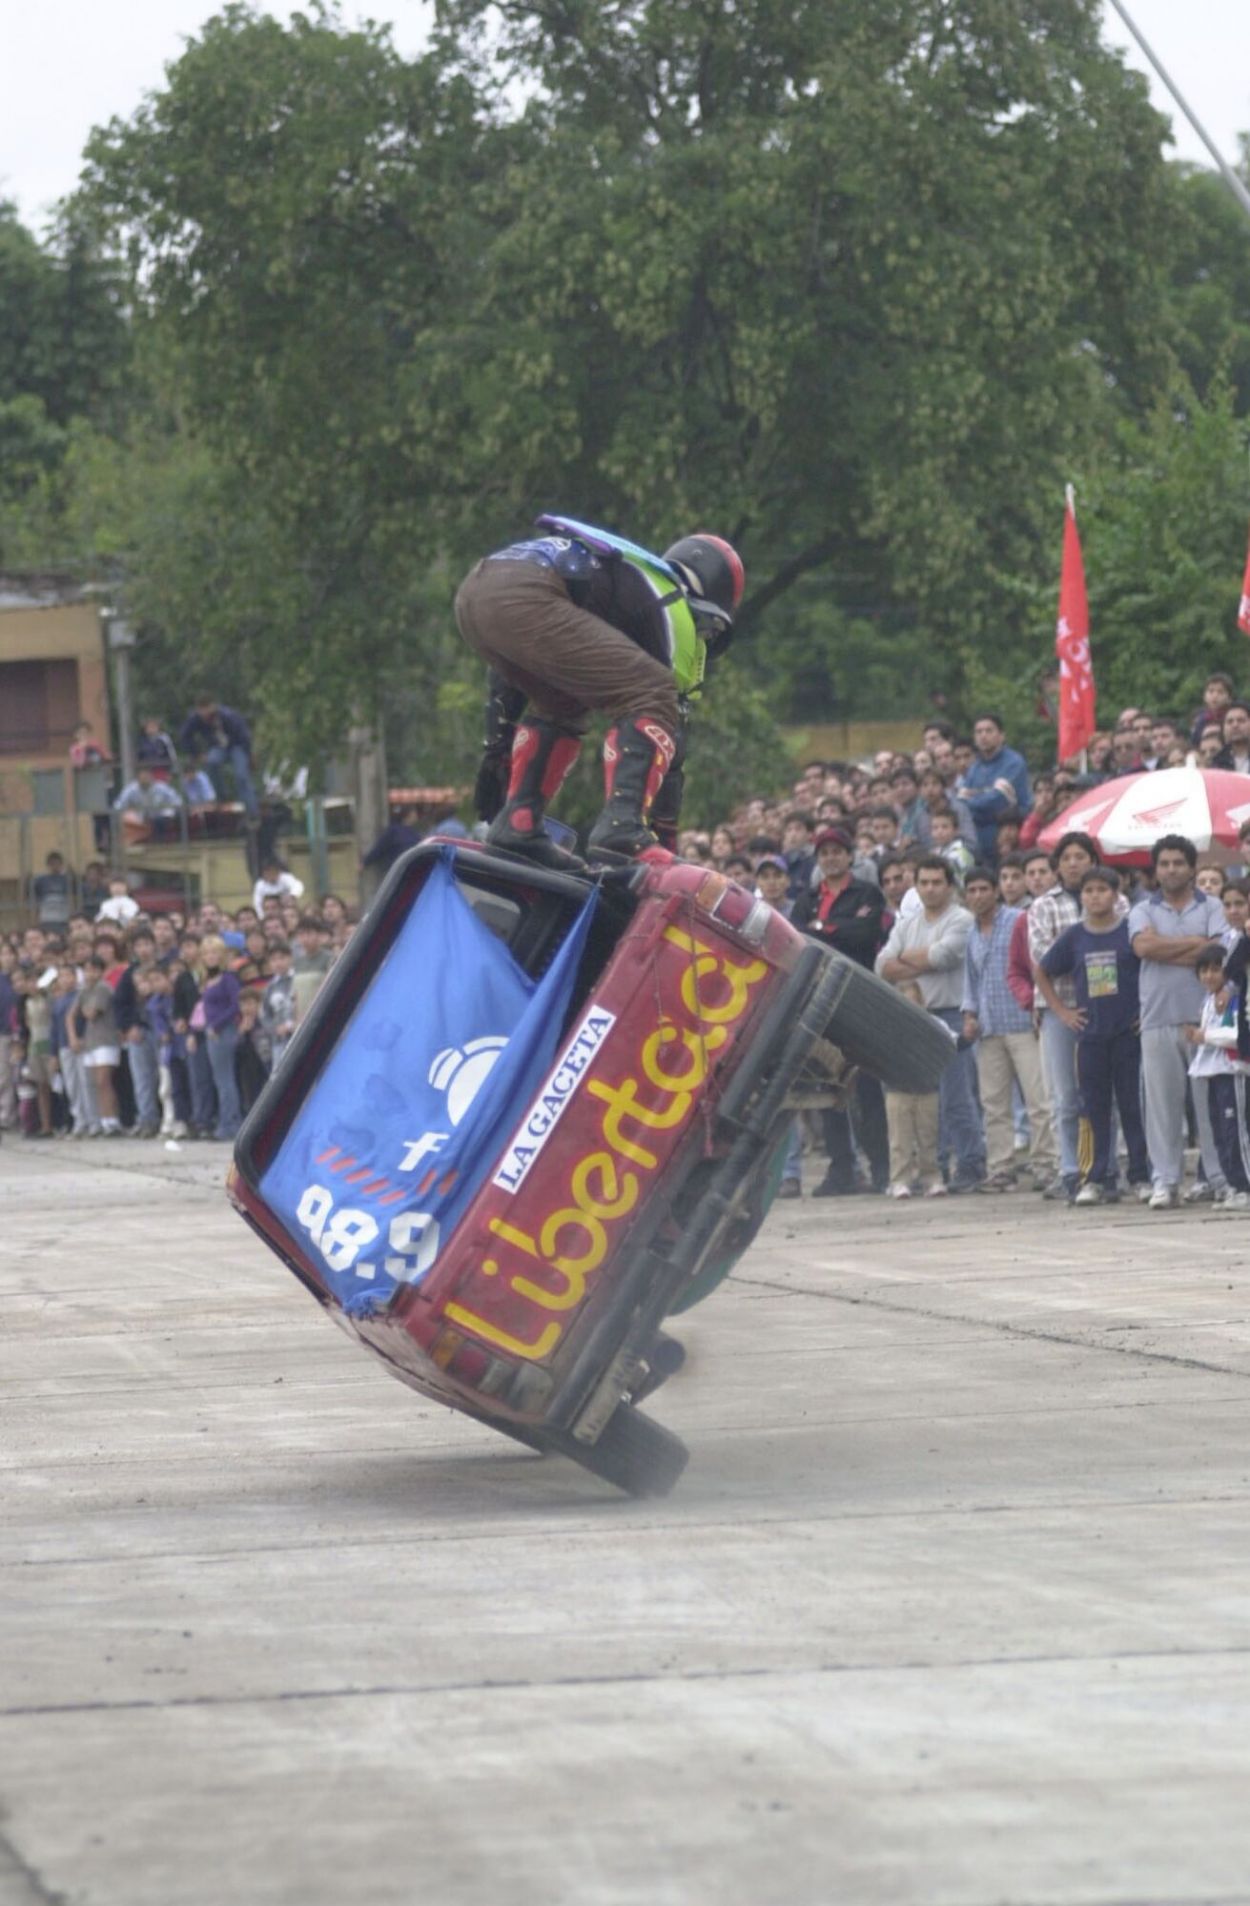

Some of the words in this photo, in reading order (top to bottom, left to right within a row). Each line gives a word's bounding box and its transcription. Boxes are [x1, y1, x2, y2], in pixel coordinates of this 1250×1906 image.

[443, 924, 768, 1360] Libertad
[499, 1145, 537, 1188] LA
[528, 1016, 611, 1137] GACETA
[296, 1184, 441, 1283] 98.9
